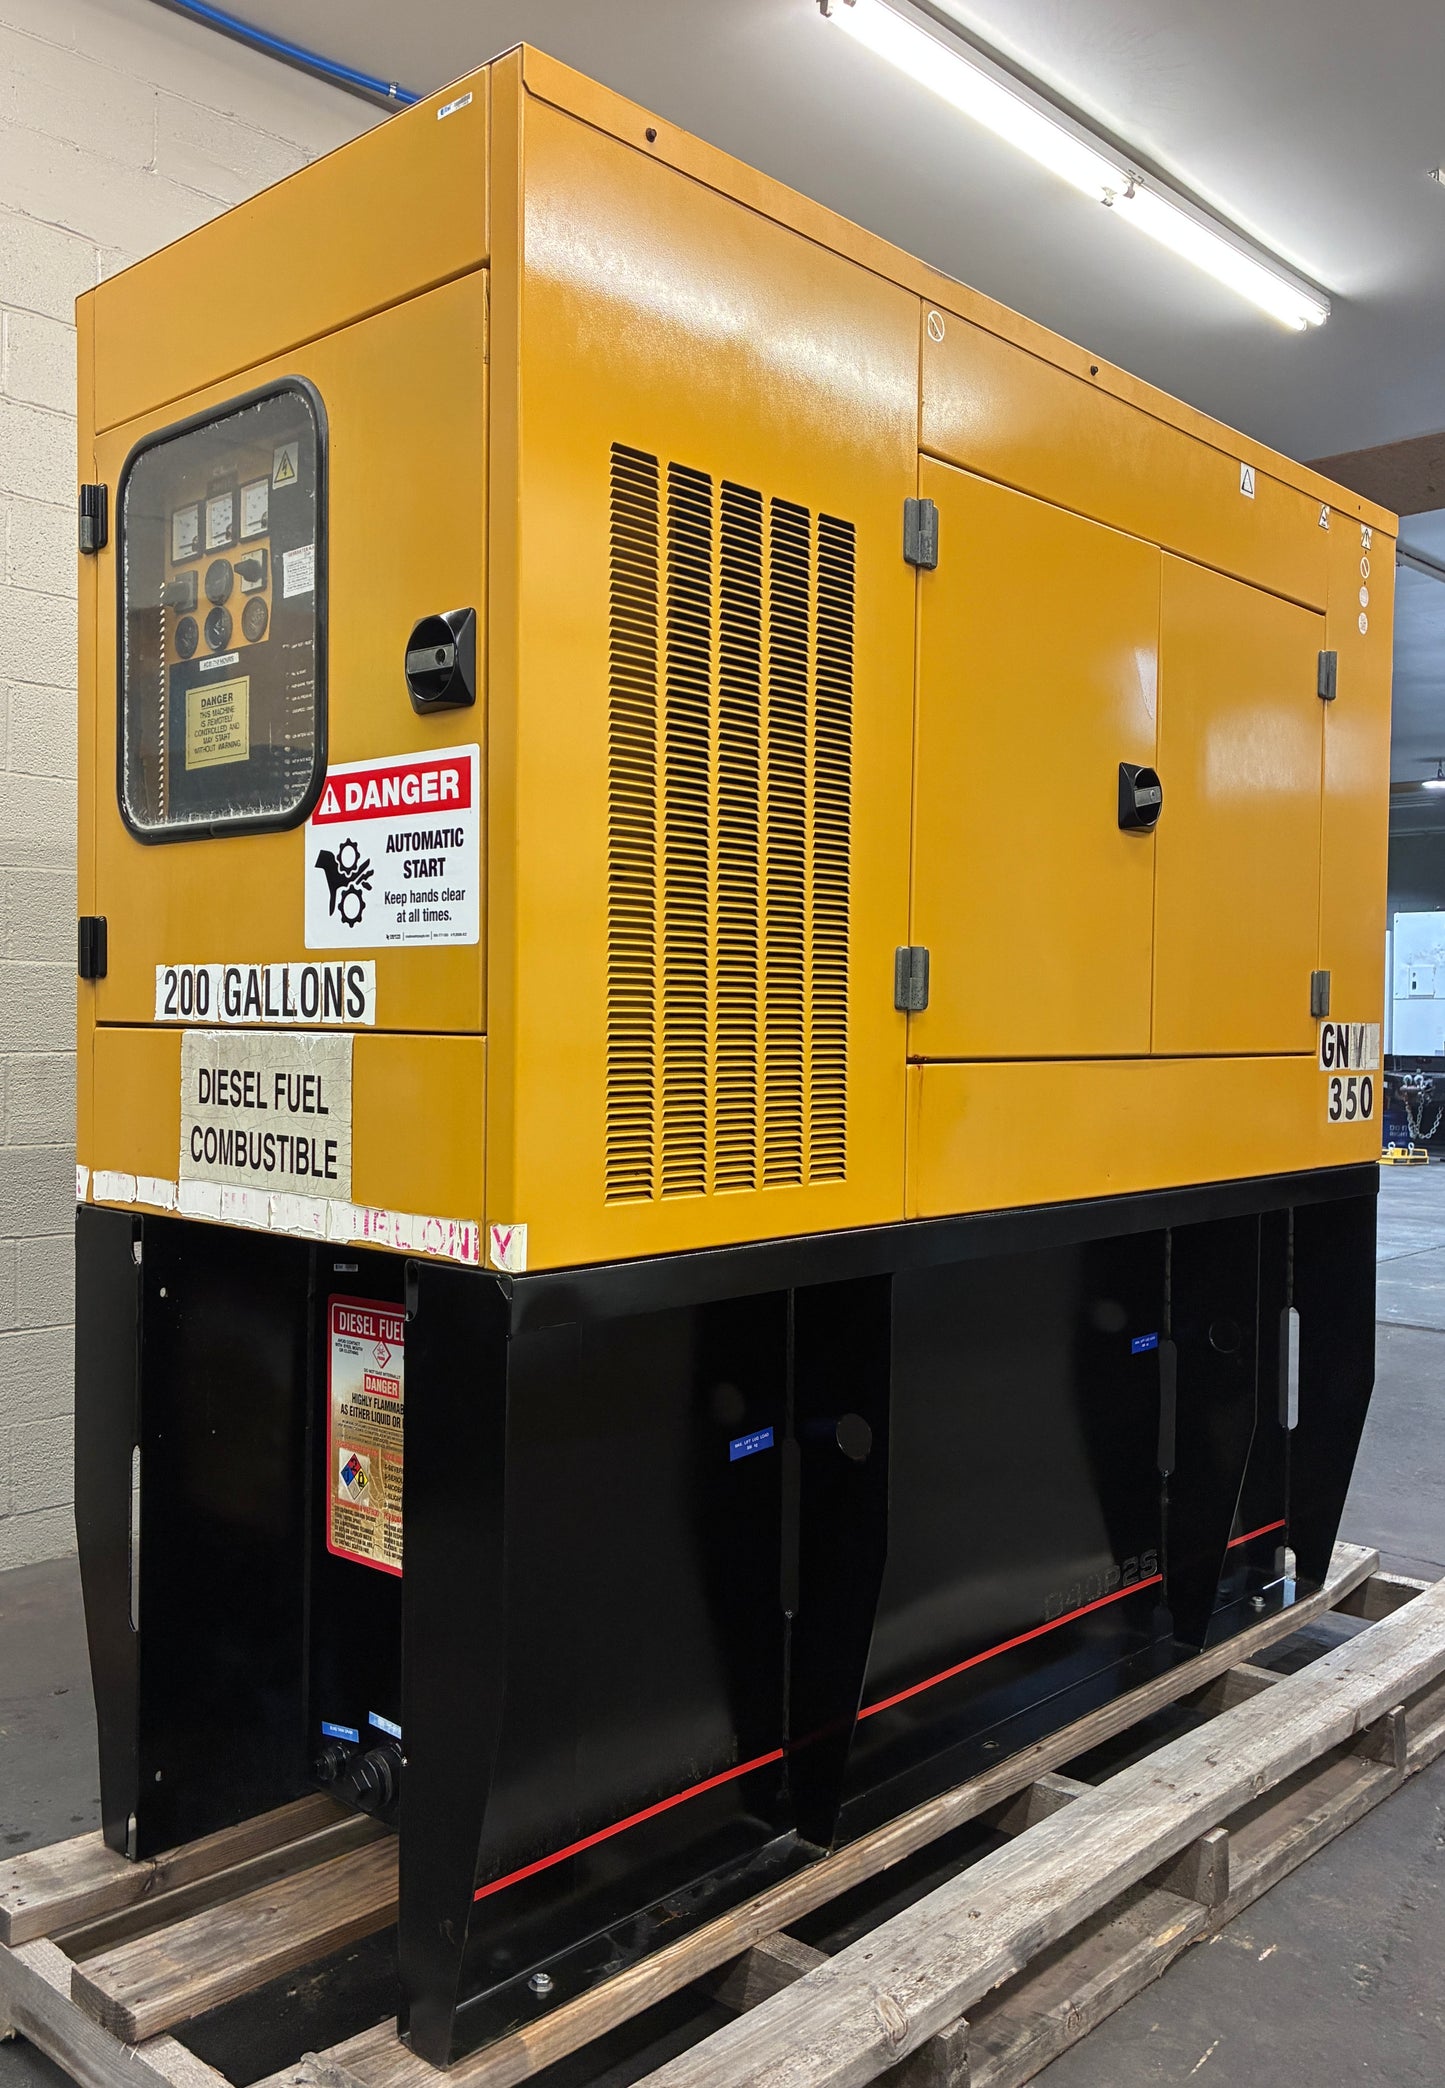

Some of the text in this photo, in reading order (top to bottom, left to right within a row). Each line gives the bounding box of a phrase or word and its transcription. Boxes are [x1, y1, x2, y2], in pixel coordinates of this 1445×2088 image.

[201, 692, 233, 708] DANGER
[200, 705, 235, 719] THIS MACHINE
[201, 714, 233, 728] IS REMOTELY
[194, 722, 239, 737] CONTROLLED AND
[203, 733, 230, 745] MAY START
[194, 740, 241, 754] WITHOUT WARNING
[345, 769, 459, 812] DANGER
[386, 827, 464, 853] AUTOMATIC
[403, 857, 446, 879] START
[384, 888, 466, 906] Keep hands clear
[397, 908, 452, 923] at all times.
[164, 965, 365, 1018] 200 GALLONS
[199, 1068, 329, 1114] DIESEL FUEL
[1329, 1076, 1373, 1121] 350
[191, 1125, 338, 1179] COMBUSTIBLE
[339, 1311, 404, 1342] DIESEL FUEL
[366, 1376, 398, 1396] DANGER
[352, 1393, 372, 1408] HIGHLY
[341, 1404, 400, 1428] AS EITHER LIQUID OR
